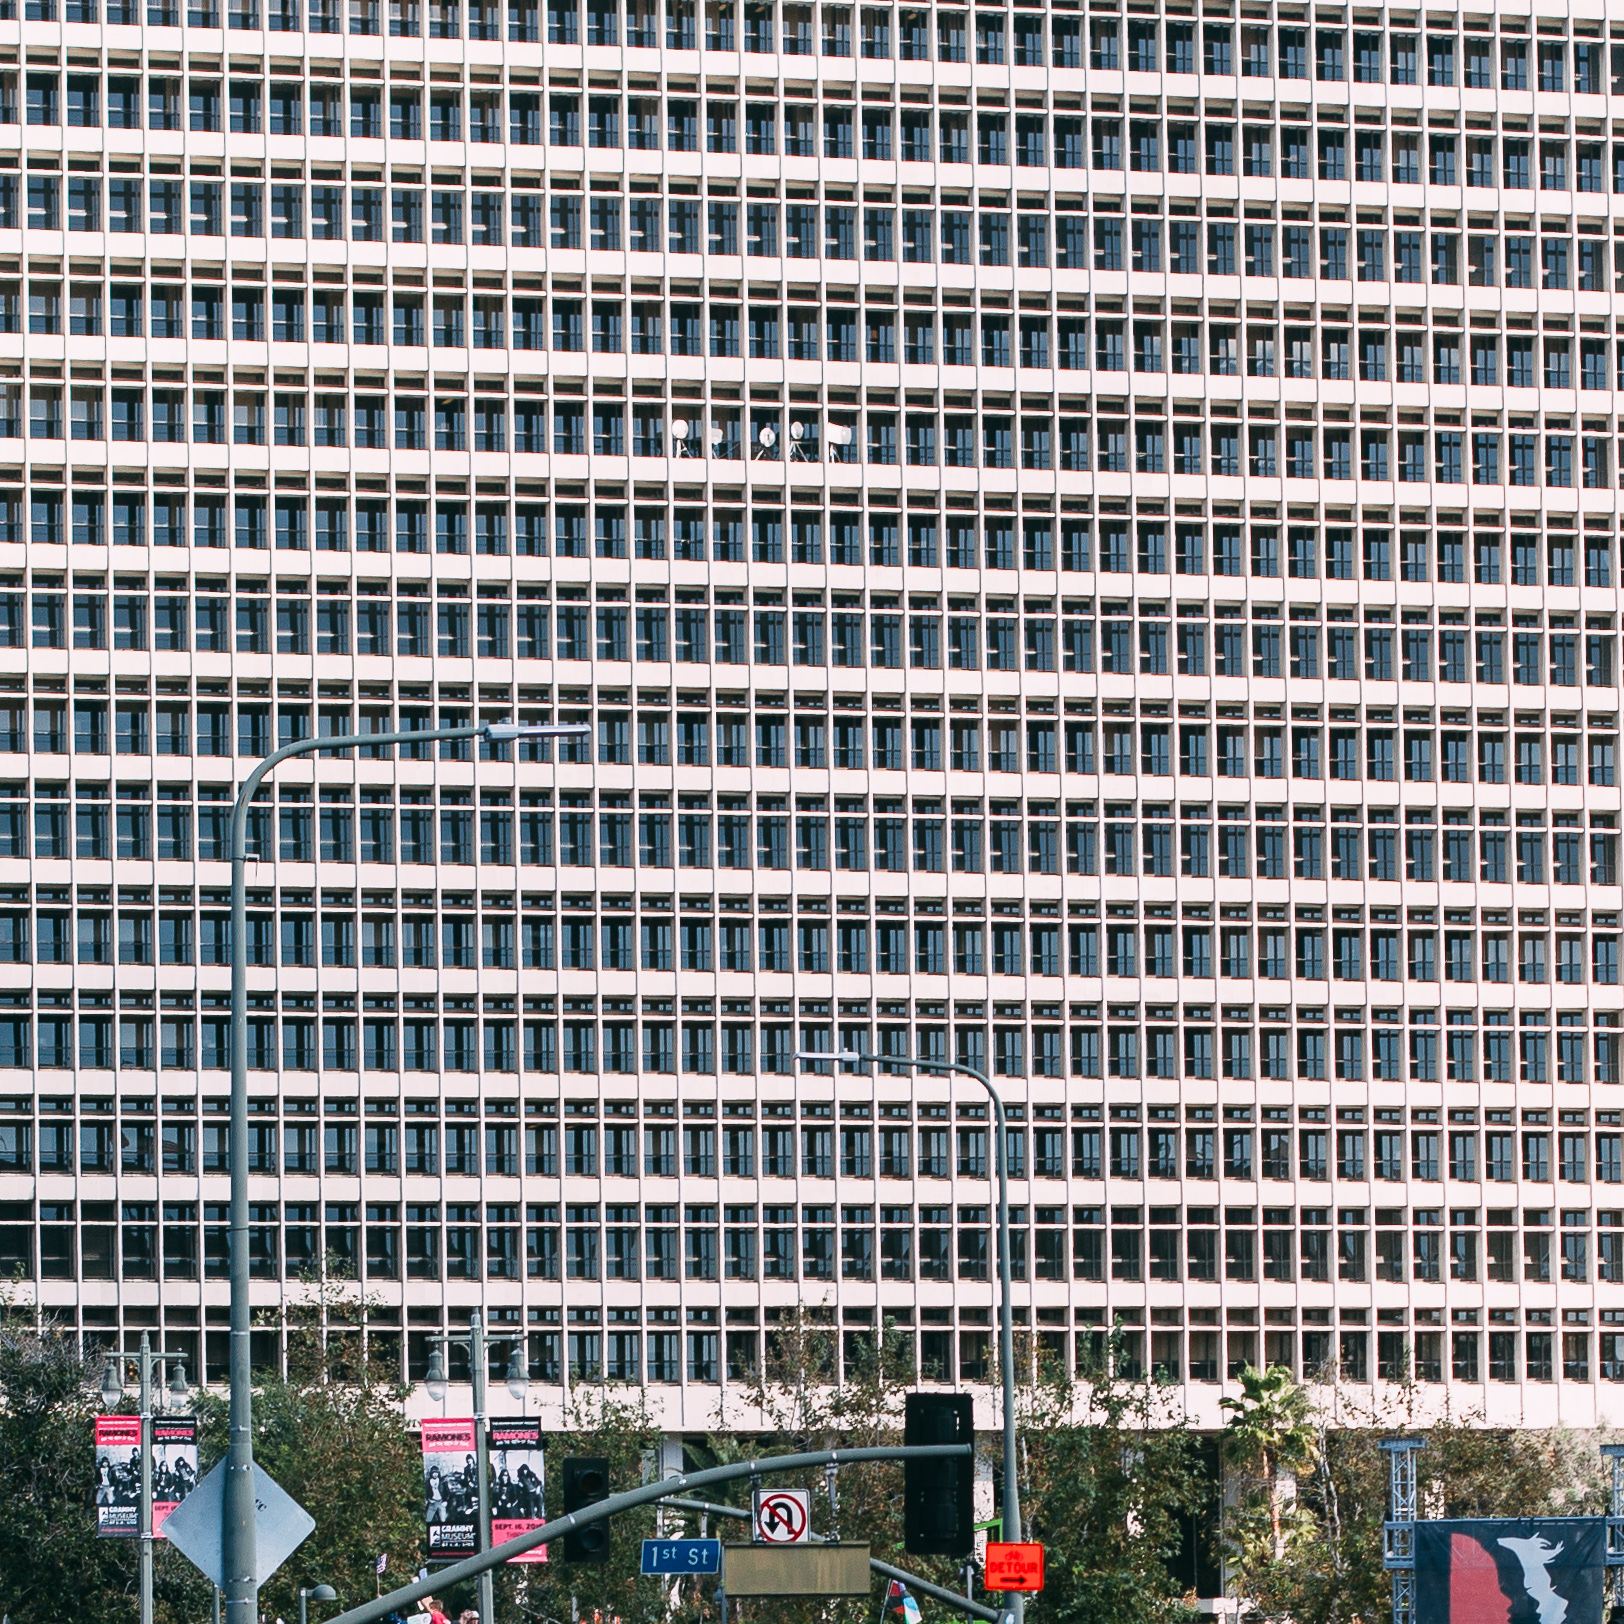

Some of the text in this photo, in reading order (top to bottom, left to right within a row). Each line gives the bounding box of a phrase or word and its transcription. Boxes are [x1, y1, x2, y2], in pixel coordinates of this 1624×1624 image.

[426, 1433, 471, 1441] RAMONES
[493, 1432, 539, 1440] RAMONES
[652, 1546, 709, 1568] 1st St
[990, 1561, 1038, 1575] DETOUR
